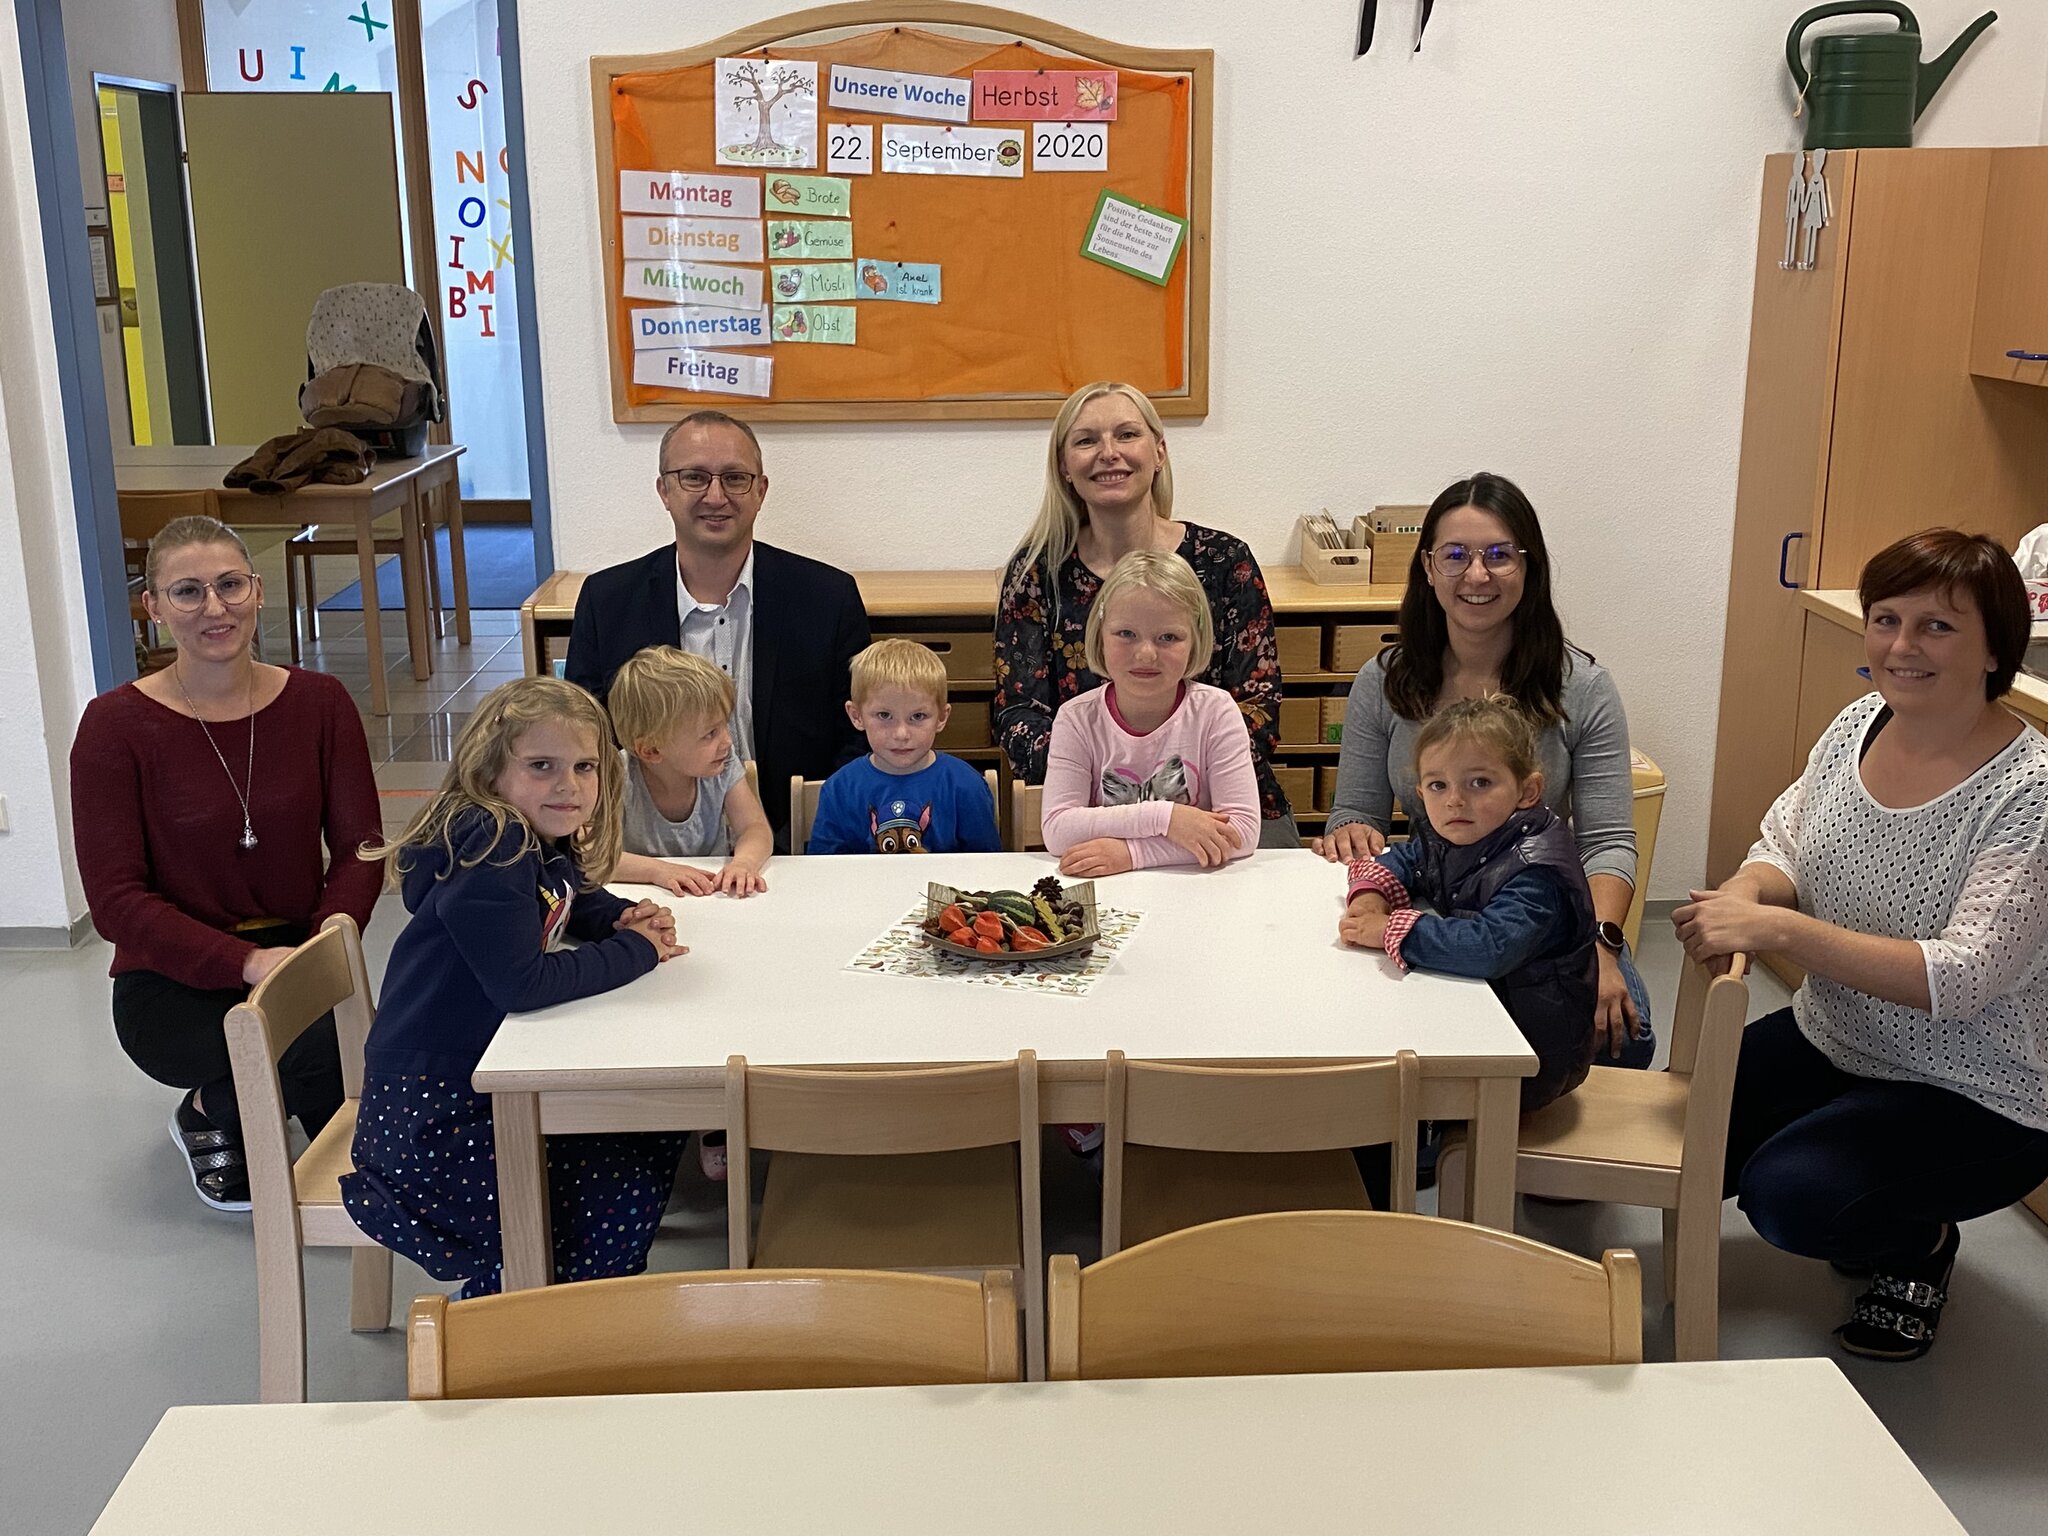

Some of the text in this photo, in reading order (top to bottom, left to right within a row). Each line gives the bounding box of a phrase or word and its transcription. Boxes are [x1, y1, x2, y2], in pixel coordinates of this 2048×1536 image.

[834, 76, 966, 106] Unsere Woche
[983, 85, 1059, 106] Herbst
[831, 136, 870, 160] 22.
[886, 139, 996, 162] September
[1037, 134, 1103, 158] 2020
[650, 181, 732, 208] Montag
[806, 187, 841, 204] Brote
[1103, 213, 1118, 224] sind
[1120, 219, 1132, 230] der
[1133, 224, 1153, 237] beste
[1107, 202, 1174, 234] Positive Gedanken
[648, 227, 740, 252] Dienstag
[804, 230, 844, 247] Gemüse
[1096, 233, 1153, 260] Sonnenseite des
[1100, 223, 1159, 251] für die Reise zur
[643, 267, 744, 296] Mittwoch
[811, 273, 845, 293] Müsli
[896, 284, 934, 296] ist krank
[641, 316, 762, 336] Donnerstag
[812, 312, 841, 332] Obst
[668, 357, 739, 385] Freitag
